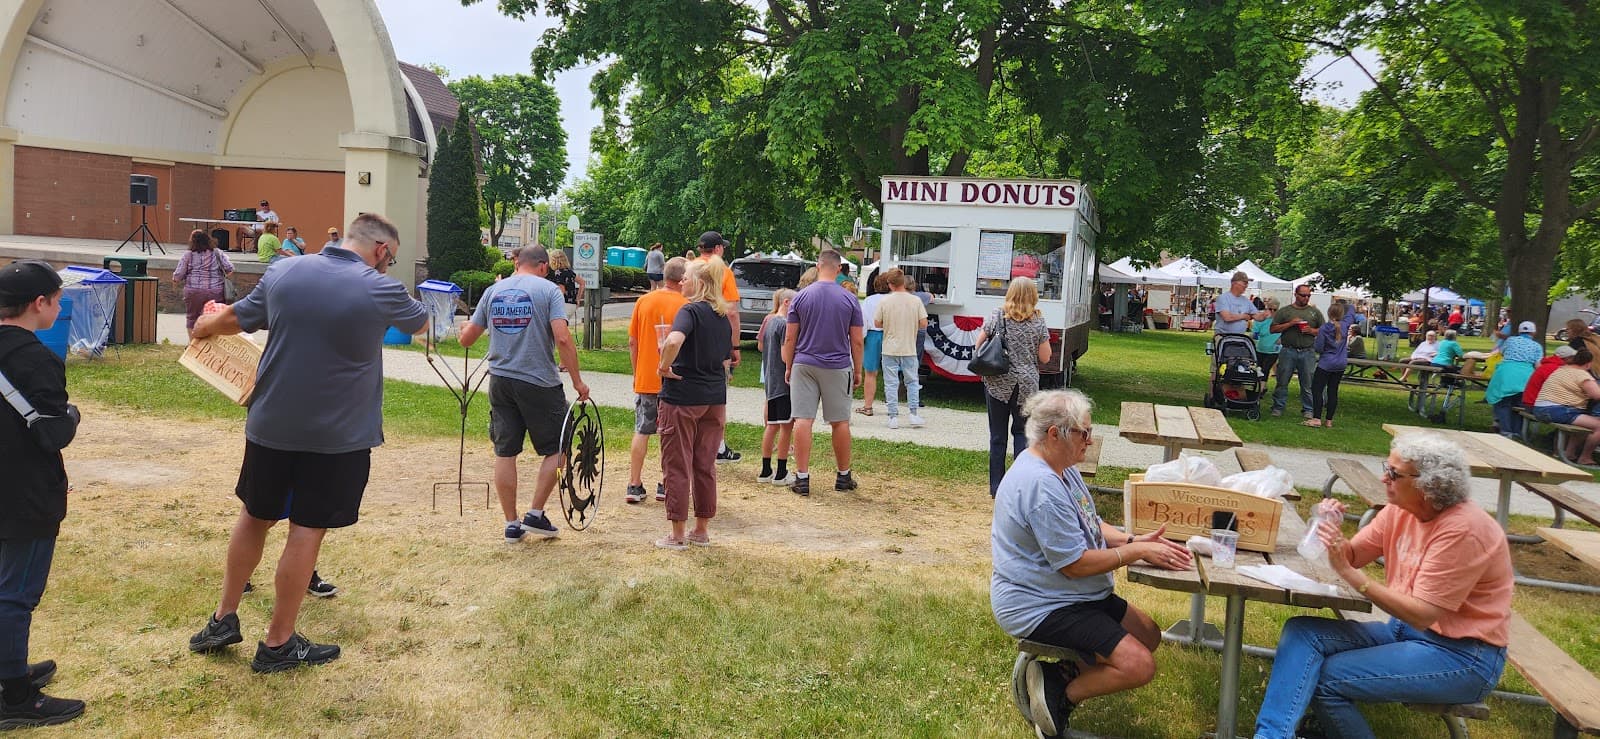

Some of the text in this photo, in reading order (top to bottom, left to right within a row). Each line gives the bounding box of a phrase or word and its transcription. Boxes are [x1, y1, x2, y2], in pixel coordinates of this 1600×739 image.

[887, 181, 1075, 206] MINI DONUTS
[505, 306, 532, 316] AMERICA
[194, 342, 249, 388] Packers
[1172, 490, 1239, 508] Wisconsin
[1148, 501, 1256, 536] Badgrs
